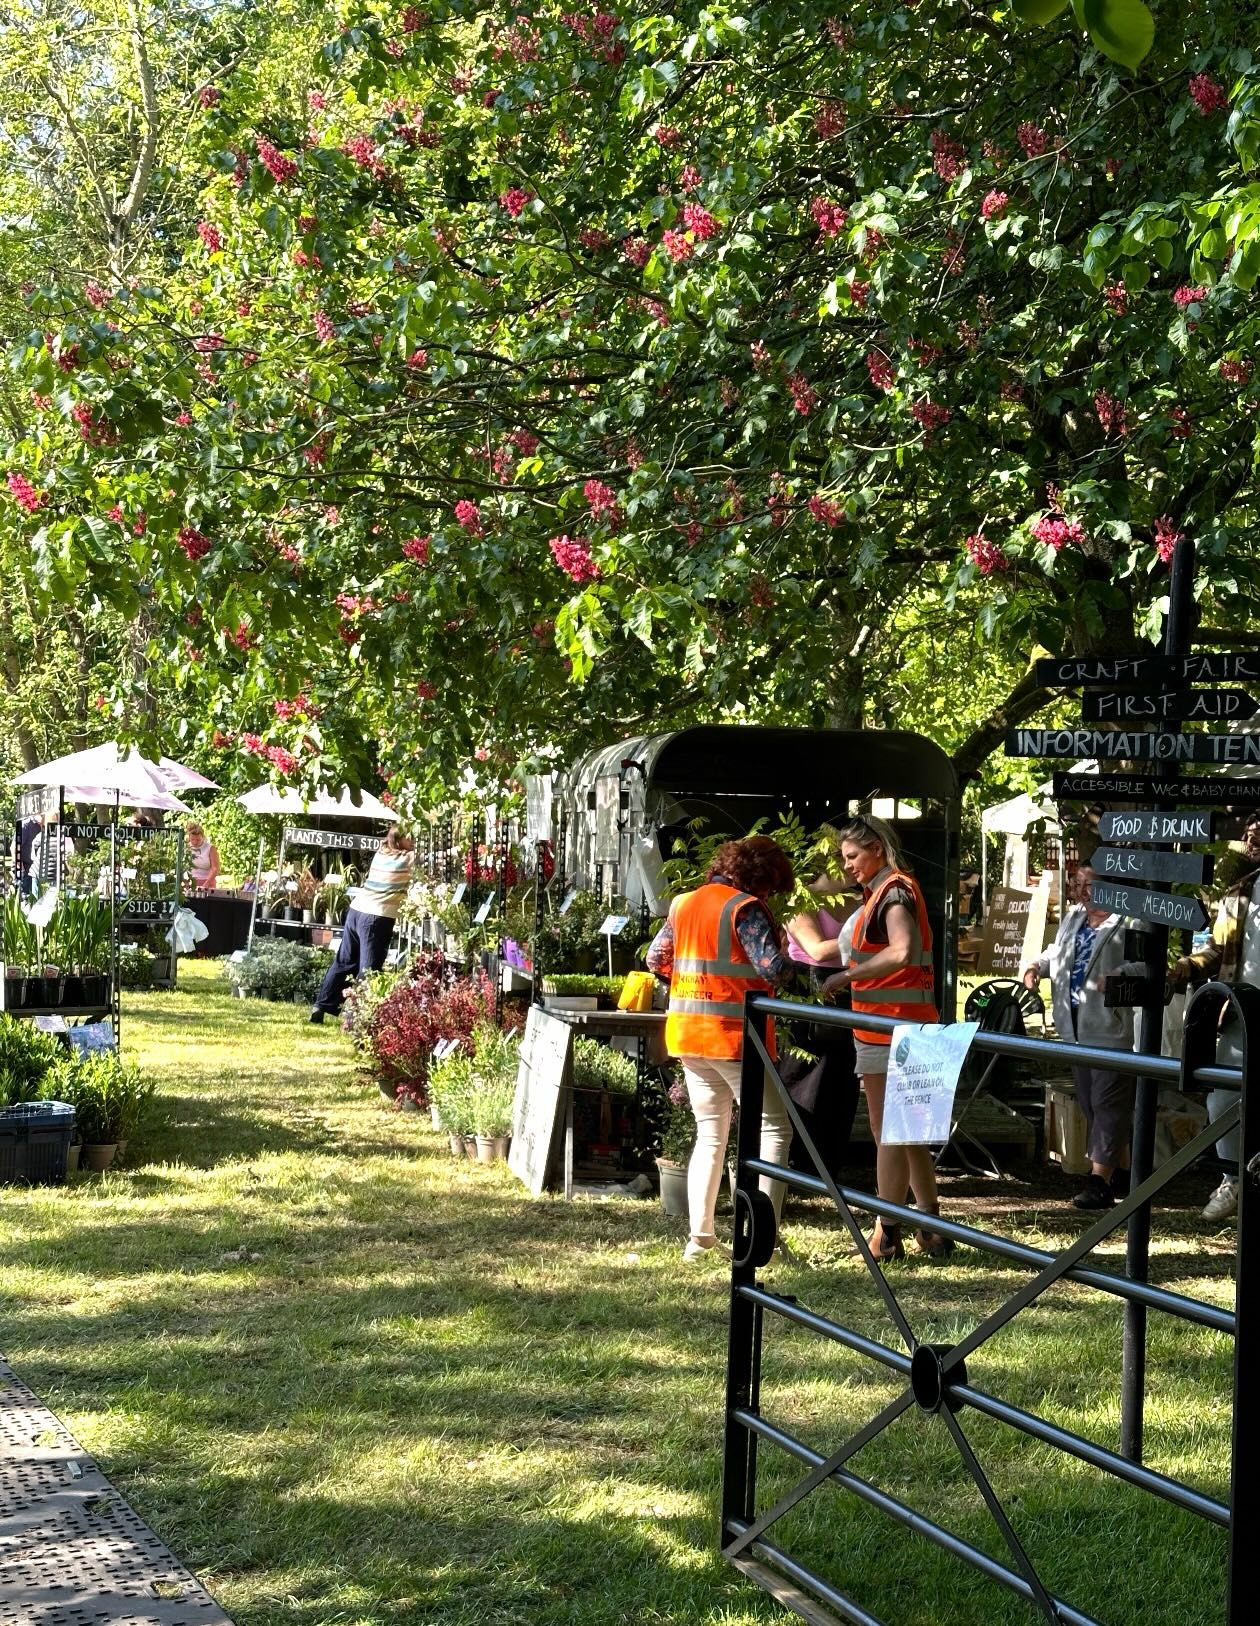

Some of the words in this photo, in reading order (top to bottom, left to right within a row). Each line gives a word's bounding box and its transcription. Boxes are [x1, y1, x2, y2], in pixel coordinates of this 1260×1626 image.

[1058, 659, 1148, 681] CRAFT
[1182, 655, 1259, 678] FAIR
[1097, 692, 1177, 717] FIRST
[1187, 694, 1240, 717] AID
[1017, 730, 1195, 760] INFORMATION
[1060, 778, 1145, 795] ACCESSIBLE
[1192, 783, 1226, 797] BABY
[48, 824, 73, 837] WY
[77, 826, 100, 839] NOT
[1109, 816, 1143, 838] FOOD
[1161, 817, 1209, 838] DRINK
[285, 829, 323, 844] PLANTS
[327, 833, 354, 848] THIS
[128, 900, 157, 914] SIDE
[1093, 886, 1130, 910] LOWER
[1143, 894, 1194, 923] MEADOW
[994, 942, 1004, 954] Our
